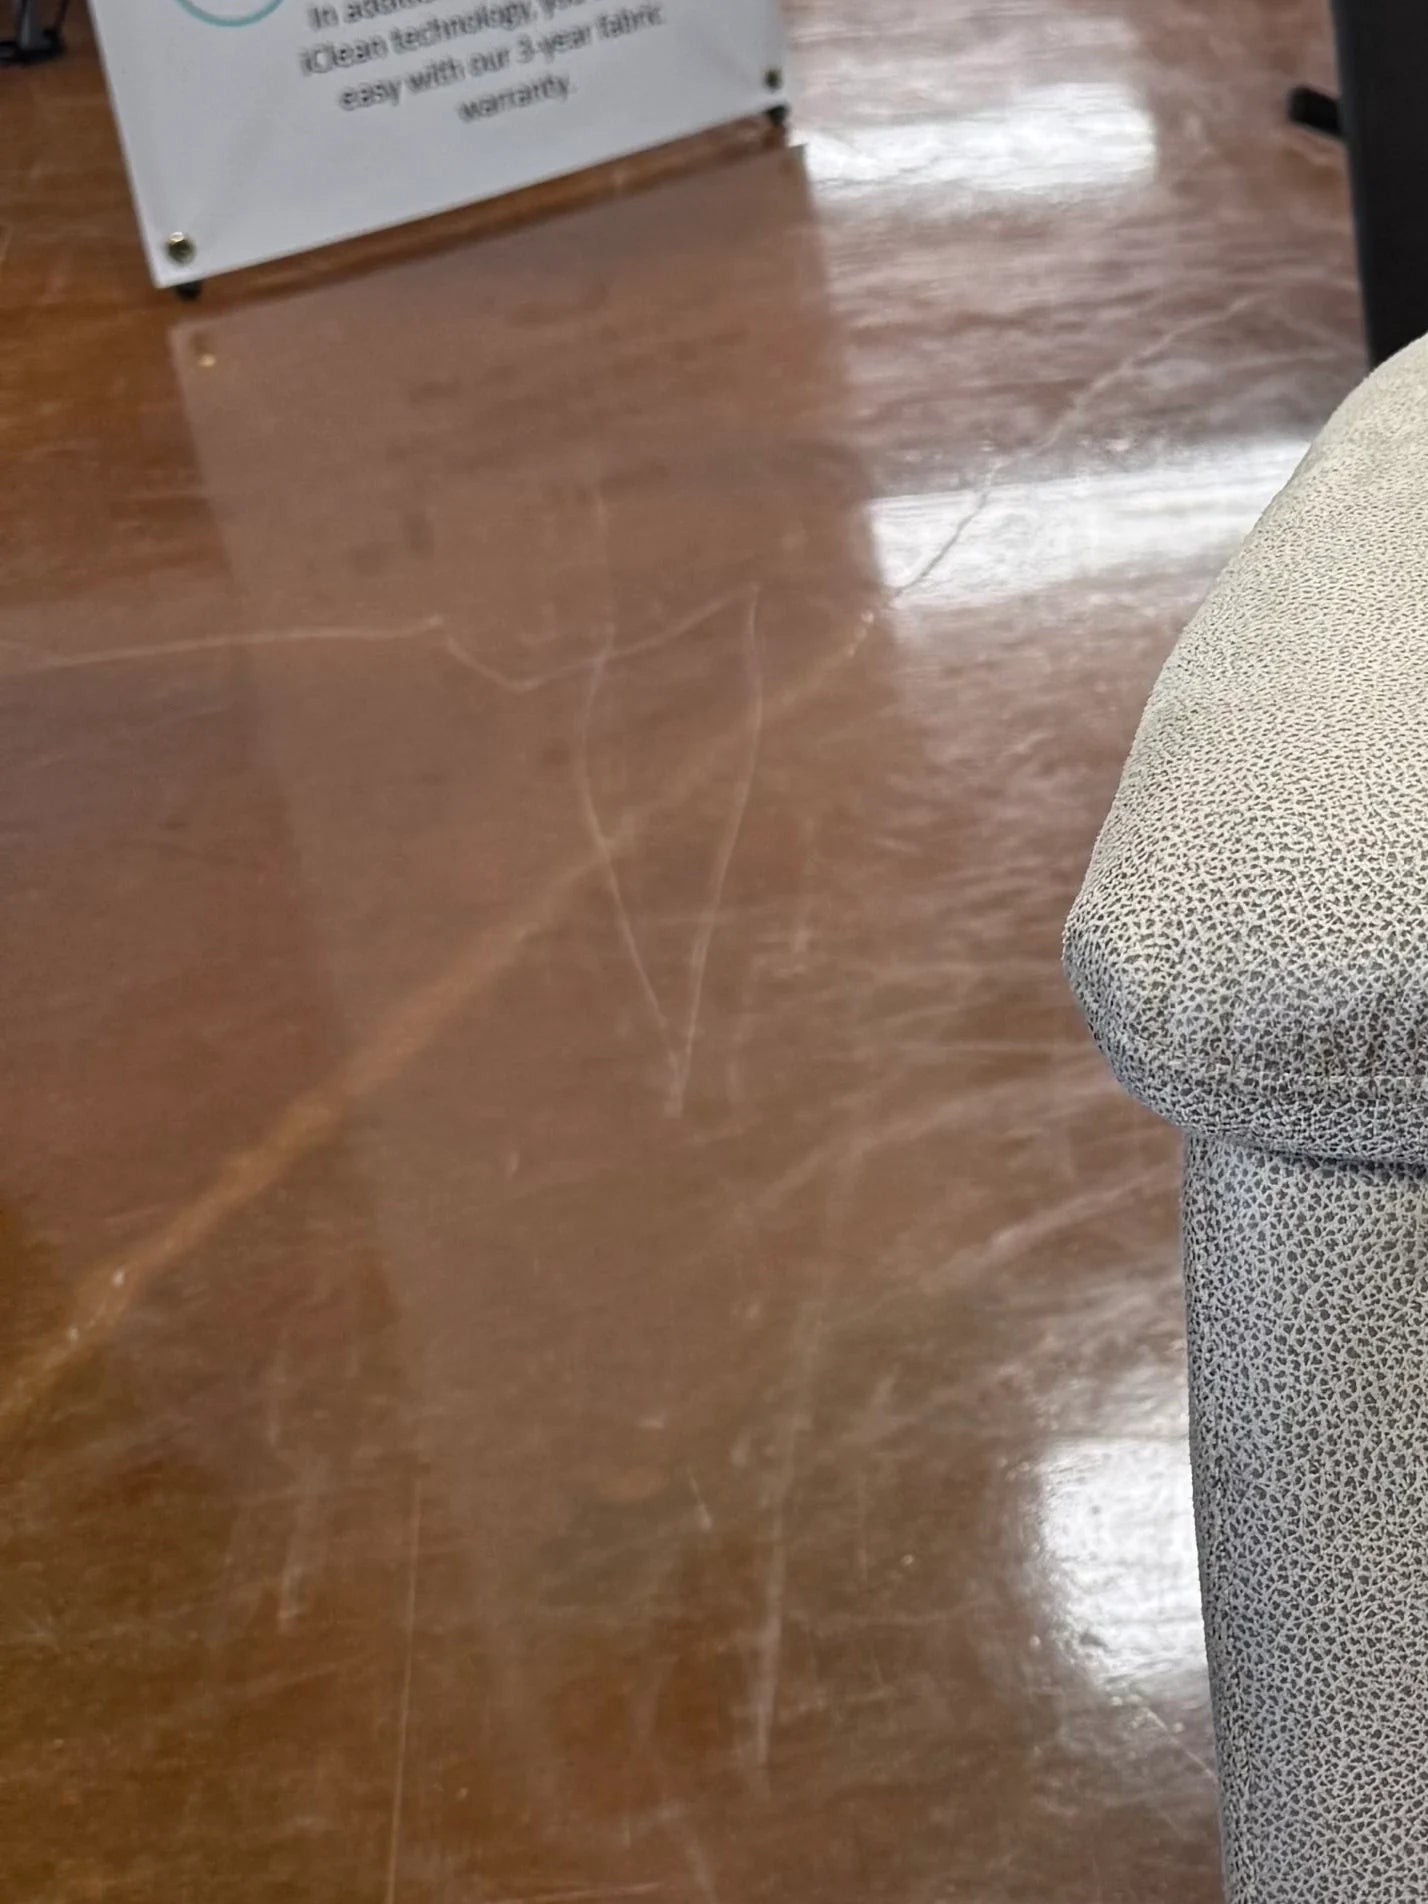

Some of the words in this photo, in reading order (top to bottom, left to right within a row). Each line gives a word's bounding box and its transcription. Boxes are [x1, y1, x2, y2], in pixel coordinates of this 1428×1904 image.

[307, 3, 339, 31] In
[299, 34, 389, 77] iClean
[338, 76, 402, 112] easy
[404, 56, 466, 95] with
[467, 46, 511, 78] our
[515, 19, 592, 65] 3-year
[594, 0, 664, 42] fabric
